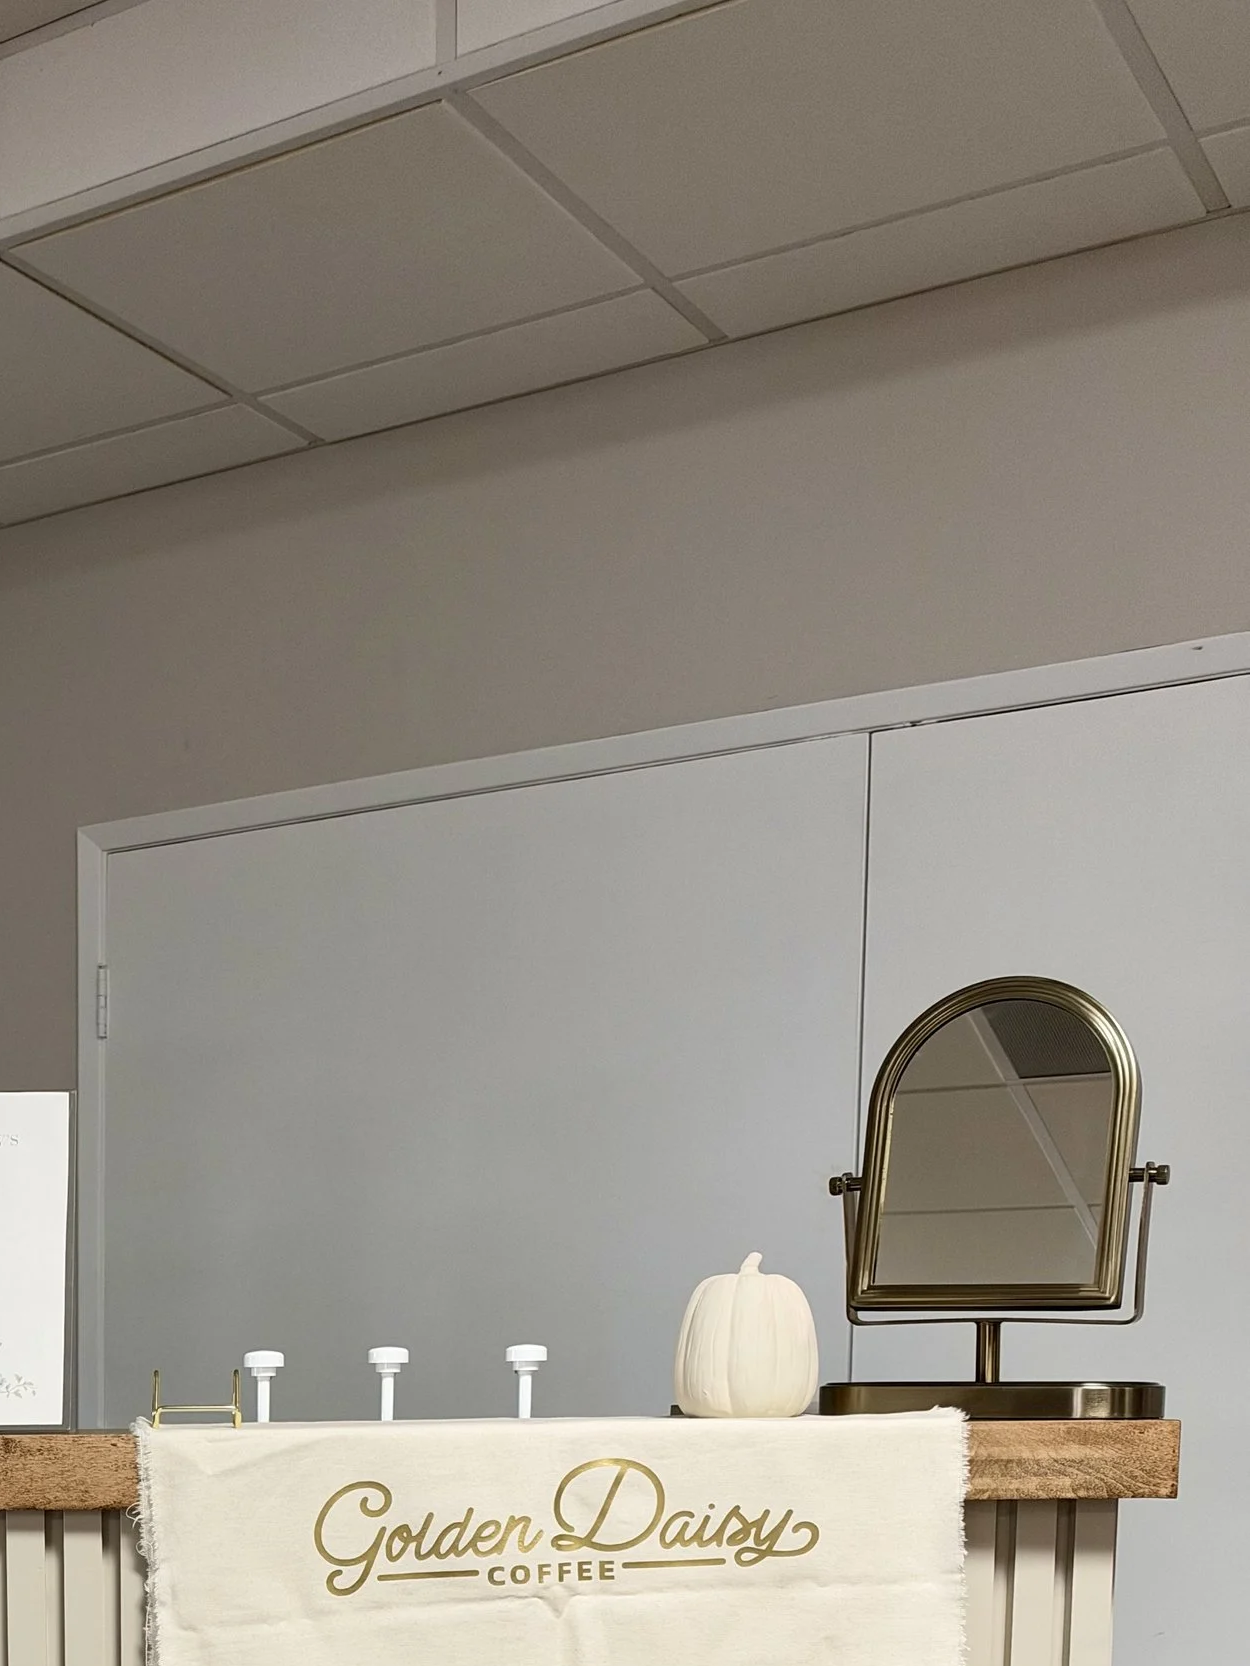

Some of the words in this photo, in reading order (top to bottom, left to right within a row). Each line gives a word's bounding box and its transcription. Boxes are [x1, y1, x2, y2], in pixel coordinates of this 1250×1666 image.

[313, 1480, 545, 1597] Golden
[551, 1457, 821, 1568] Daisy
[487, 1559, 617, 1588] COFFEE
